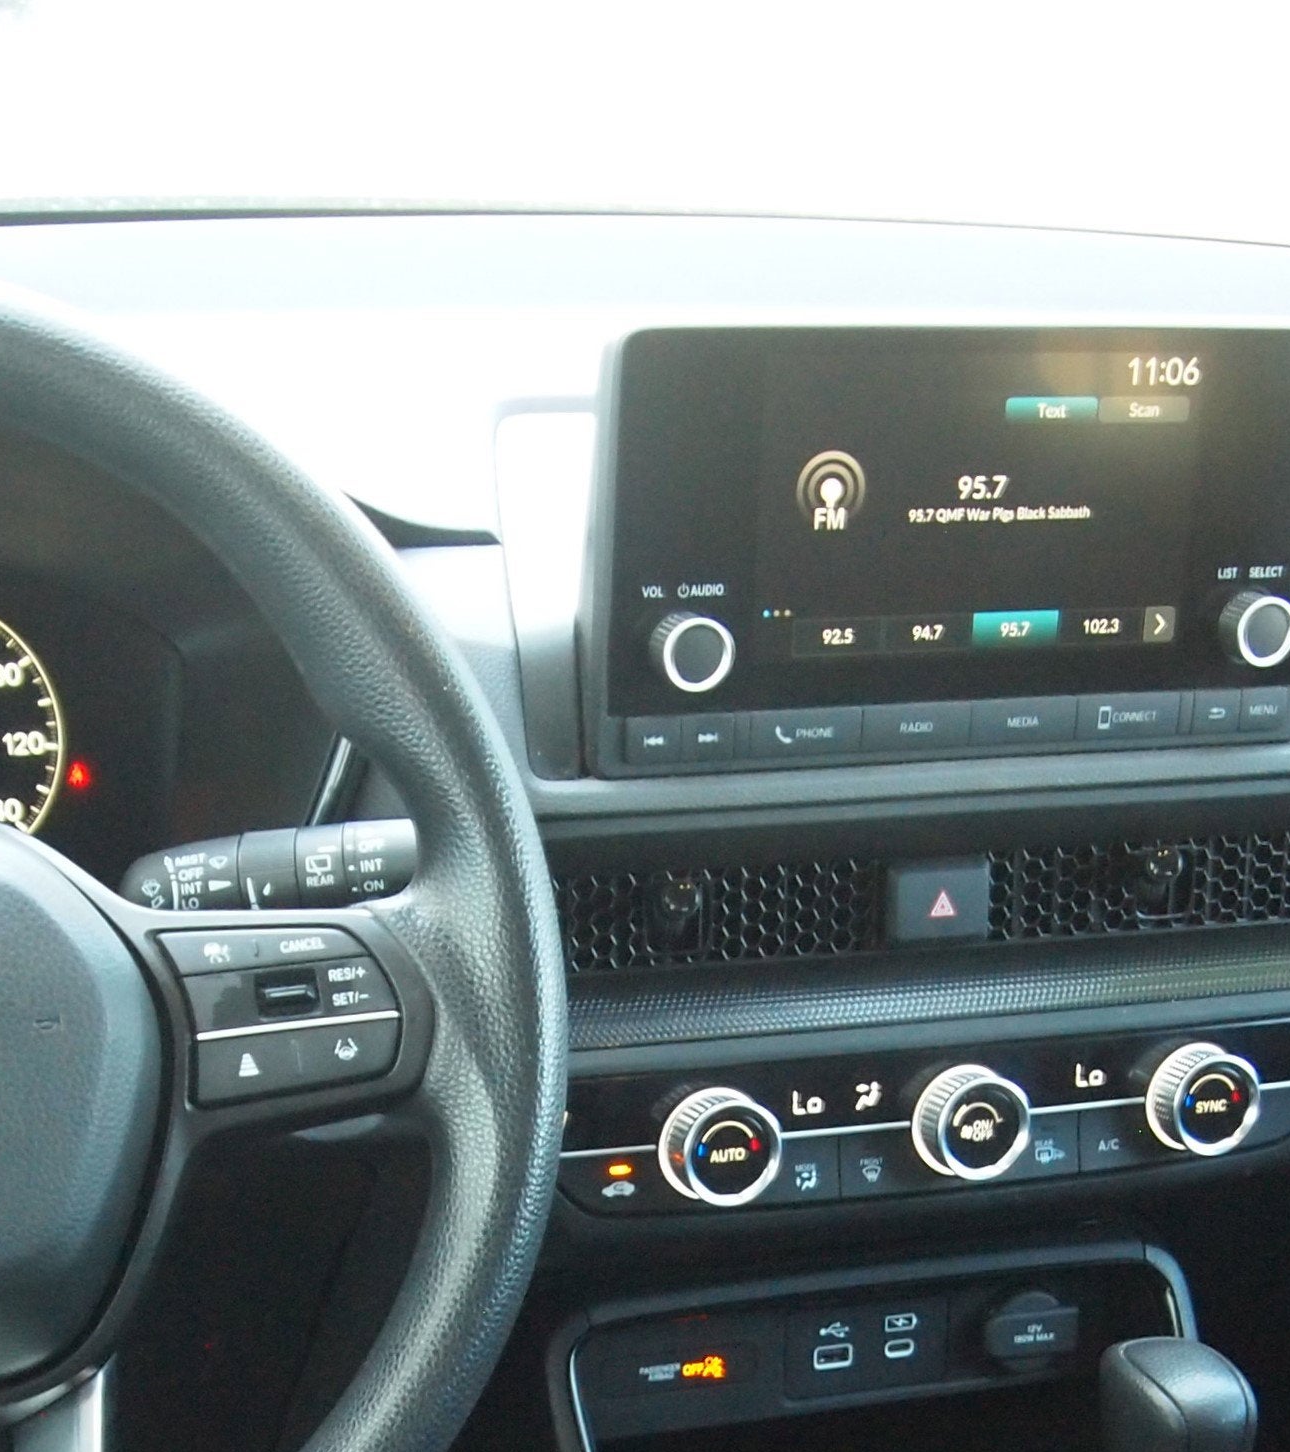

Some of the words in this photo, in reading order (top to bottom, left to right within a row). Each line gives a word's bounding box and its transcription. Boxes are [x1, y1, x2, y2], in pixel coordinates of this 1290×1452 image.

[1128, 356, 1202, 386] 11:06
[1037, 402, 1066, 418] Text
[1128, 402, 1160, 418] Scan
[958, 475, 1009, 500] 95.7
[814, 507, 847, 530] FM
[908, 508, 935, 523] 95.7
[936, 507, 964, 523] QMF
[966, 507, 990, 522] War
[1017, 506, 1045, 520] Black
[1047, 505, 1091, 519] Sabbath
[1217, 566, 1238, 580] LIST
[1248, 565, 1284, 579] SELECT
[641, 586, 664, 598] VOL
[690, 583, 725, 597] AUDIO
[822, 628, 855, 645] 92.5
[912, 624, 944, 642] 94.7
[1000, 621, 1031, 638] 95.7
[1083, 618, 1120, 635] 102.3
[1112, 711, 1157, 723] CONNECT
[1249, 705, 1278, 716] MENU
[899, 721, 934, 734] RADIO
[1007, 716, 1039, 728] MEDIA
[795, 726, 834, 739] PHONE
[1, 730, 46, 756] 120
[359, 858, 383, 873] INT
[178, 866, 204, 881] OFF
[306, 874, 334, 887] REAR
[180, 881, 202, 895] INT
[363, 879, 384, 892] ON
[182, 897, 199, 909] LO
[279, 937, 326, 953] CANCEL
[1195, 1098, 1229, 1114] SYNC
[972, 1129, 994, 1142] OFF
[1098, 1138, 1120, 1151] A/C
[710, 1147, 747, 1163] AUTO
[682, 1363, 704, 1377] OFF
